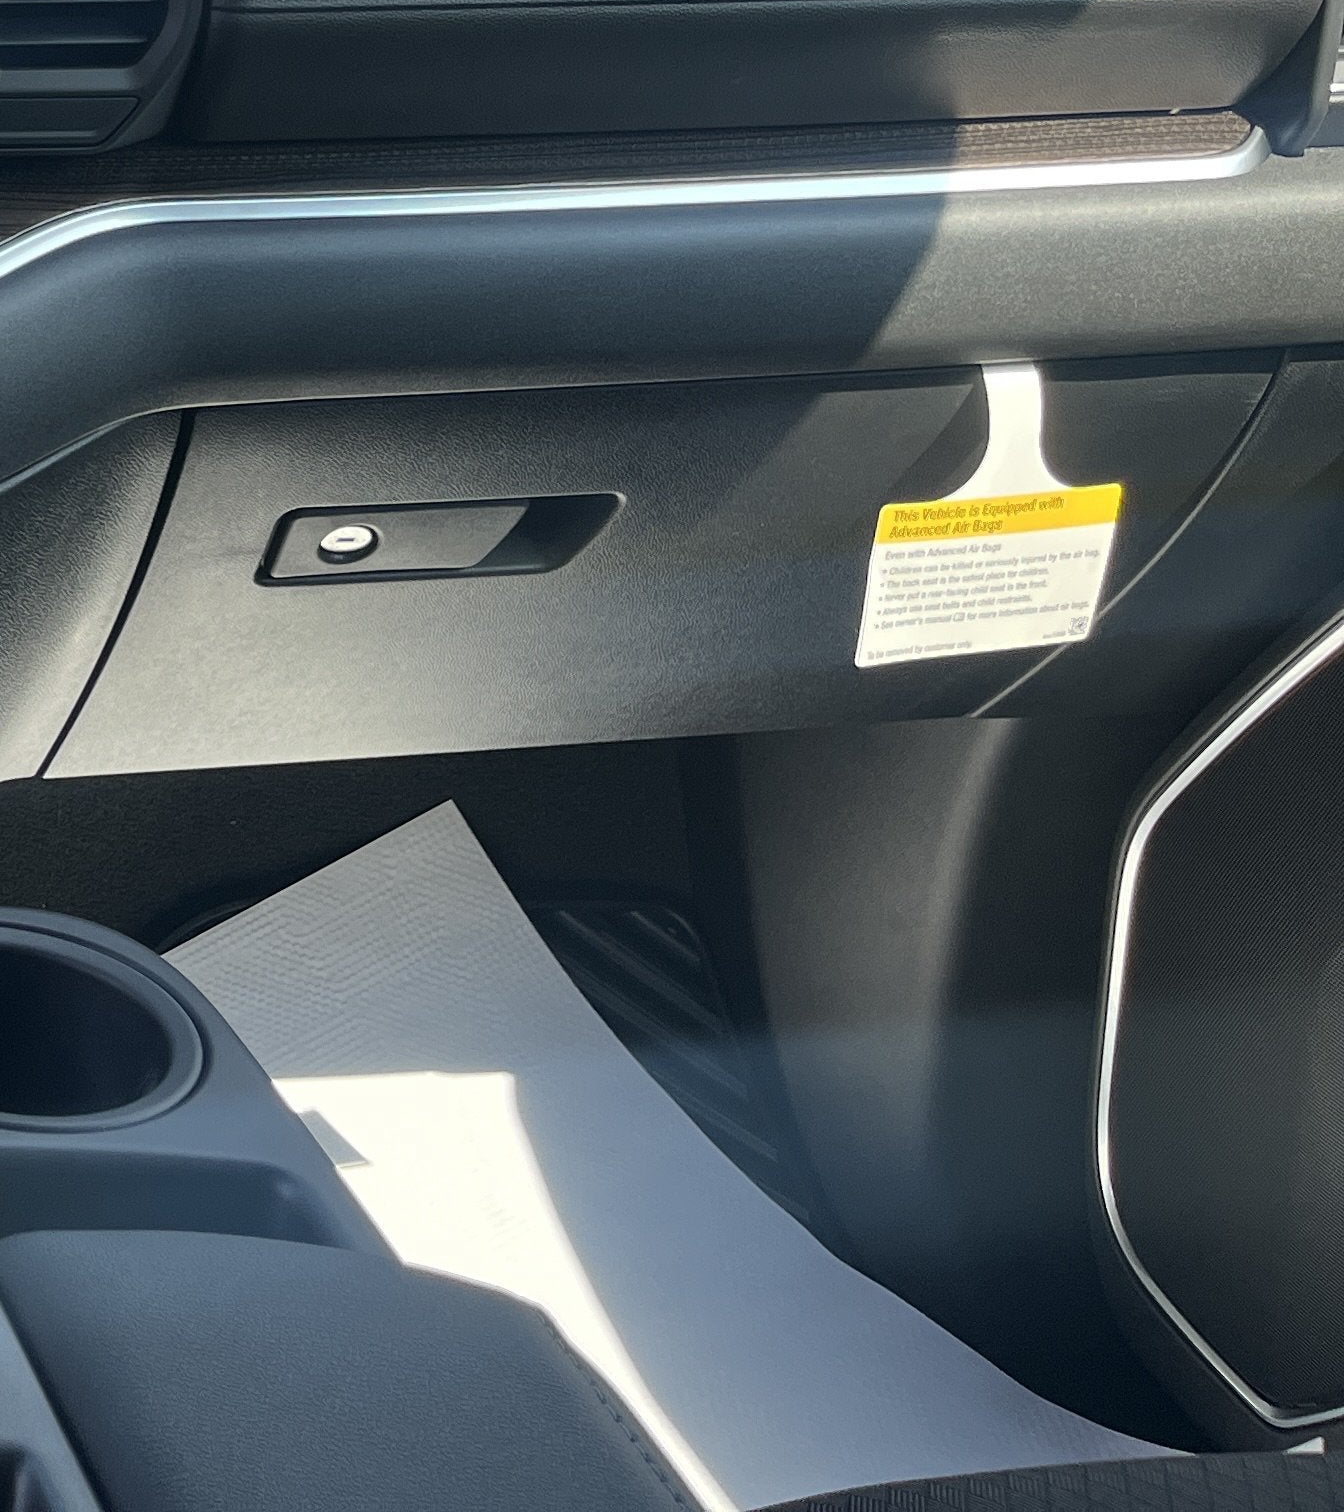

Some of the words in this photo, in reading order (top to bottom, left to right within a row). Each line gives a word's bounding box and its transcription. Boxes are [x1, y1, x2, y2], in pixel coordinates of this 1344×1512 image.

[894, 510, 919, 522] This
[923, 507, 966, 520] Vehicle
[969, 504, 980, 517] is
[982, 498, 1037, 517] Equipped
[1039, 496, 1064, 510] with
[889, 522, 950, 538] Advanced
[952, 521, 971, 534] Air
[973, 519, 1003, 533] Bags
